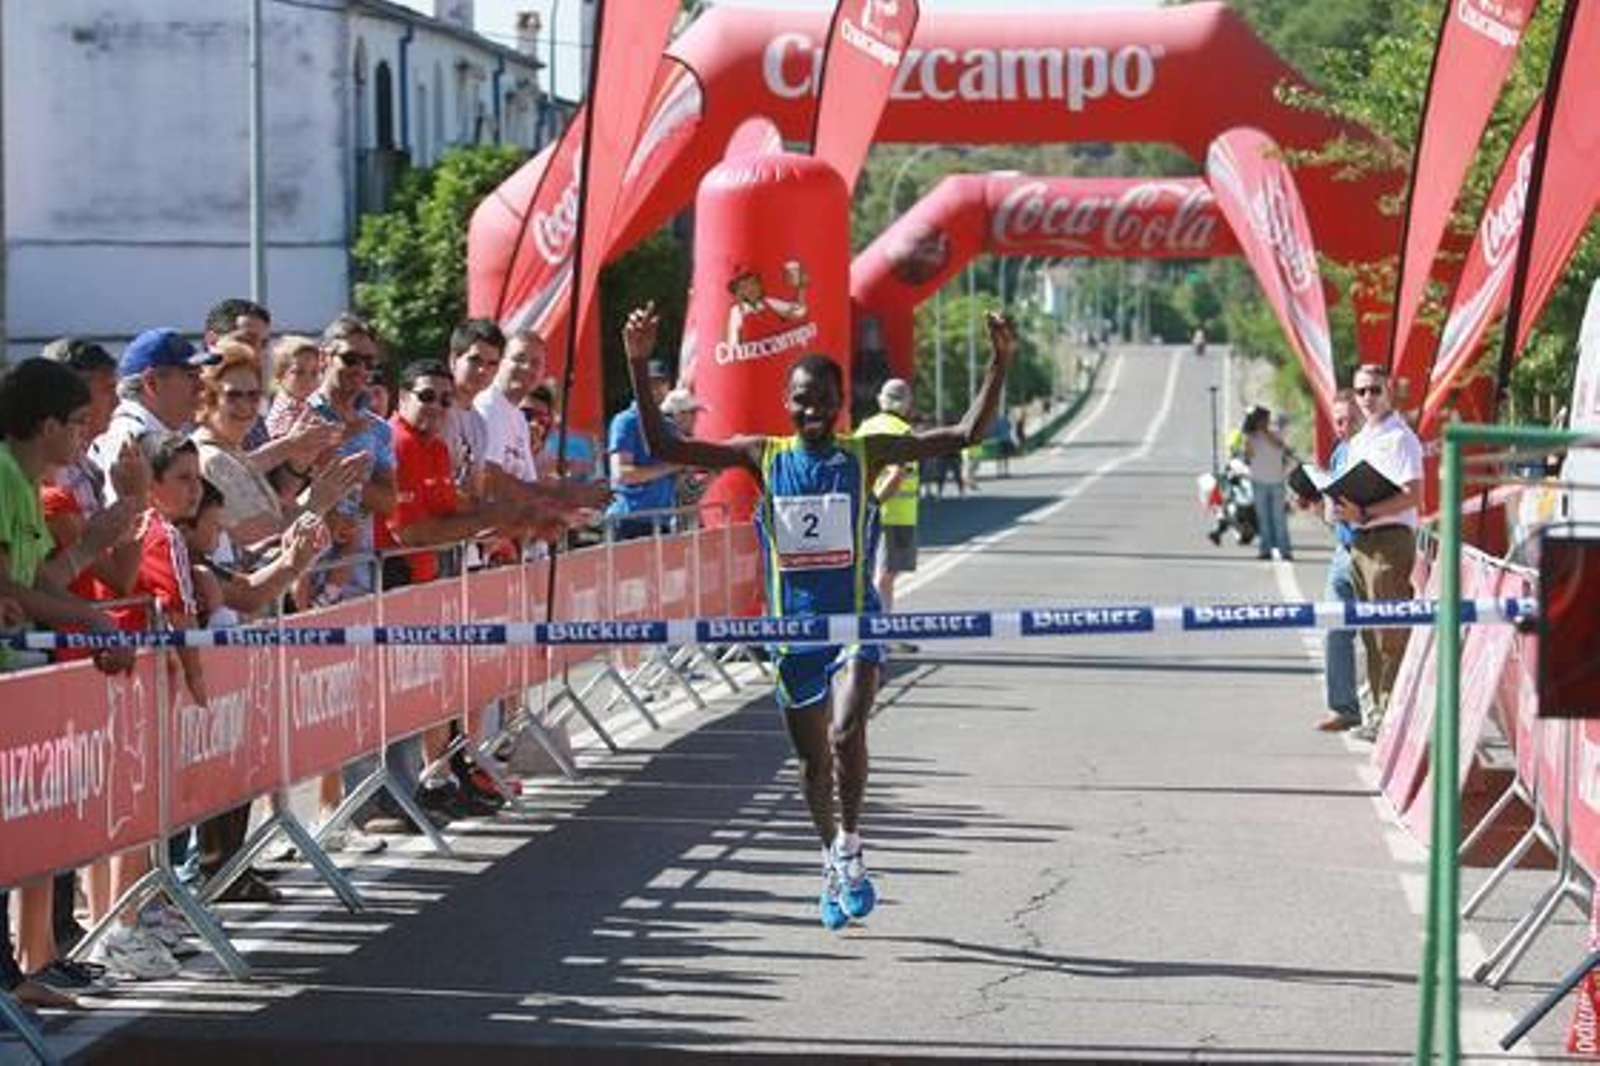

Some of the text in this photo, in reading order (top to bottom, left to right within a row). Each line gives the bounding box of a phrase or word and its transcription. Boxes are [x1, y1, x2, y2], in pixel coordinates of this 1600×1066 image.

[762, 32, 1155, 111] Czcampo
[715, 322, 817, 365] Cruzcampo
[802, 513, 819, 538] 2
[1355, 601, 1440, 617] Buckl
[387, 625, 493, 643] Buckler
[548, 622, 654, 641] Buckler
[709, 616, 815, 638] Buckler
[871, 614, 976, 634] Buckler
[67, 631, 172, 648] Buckler
